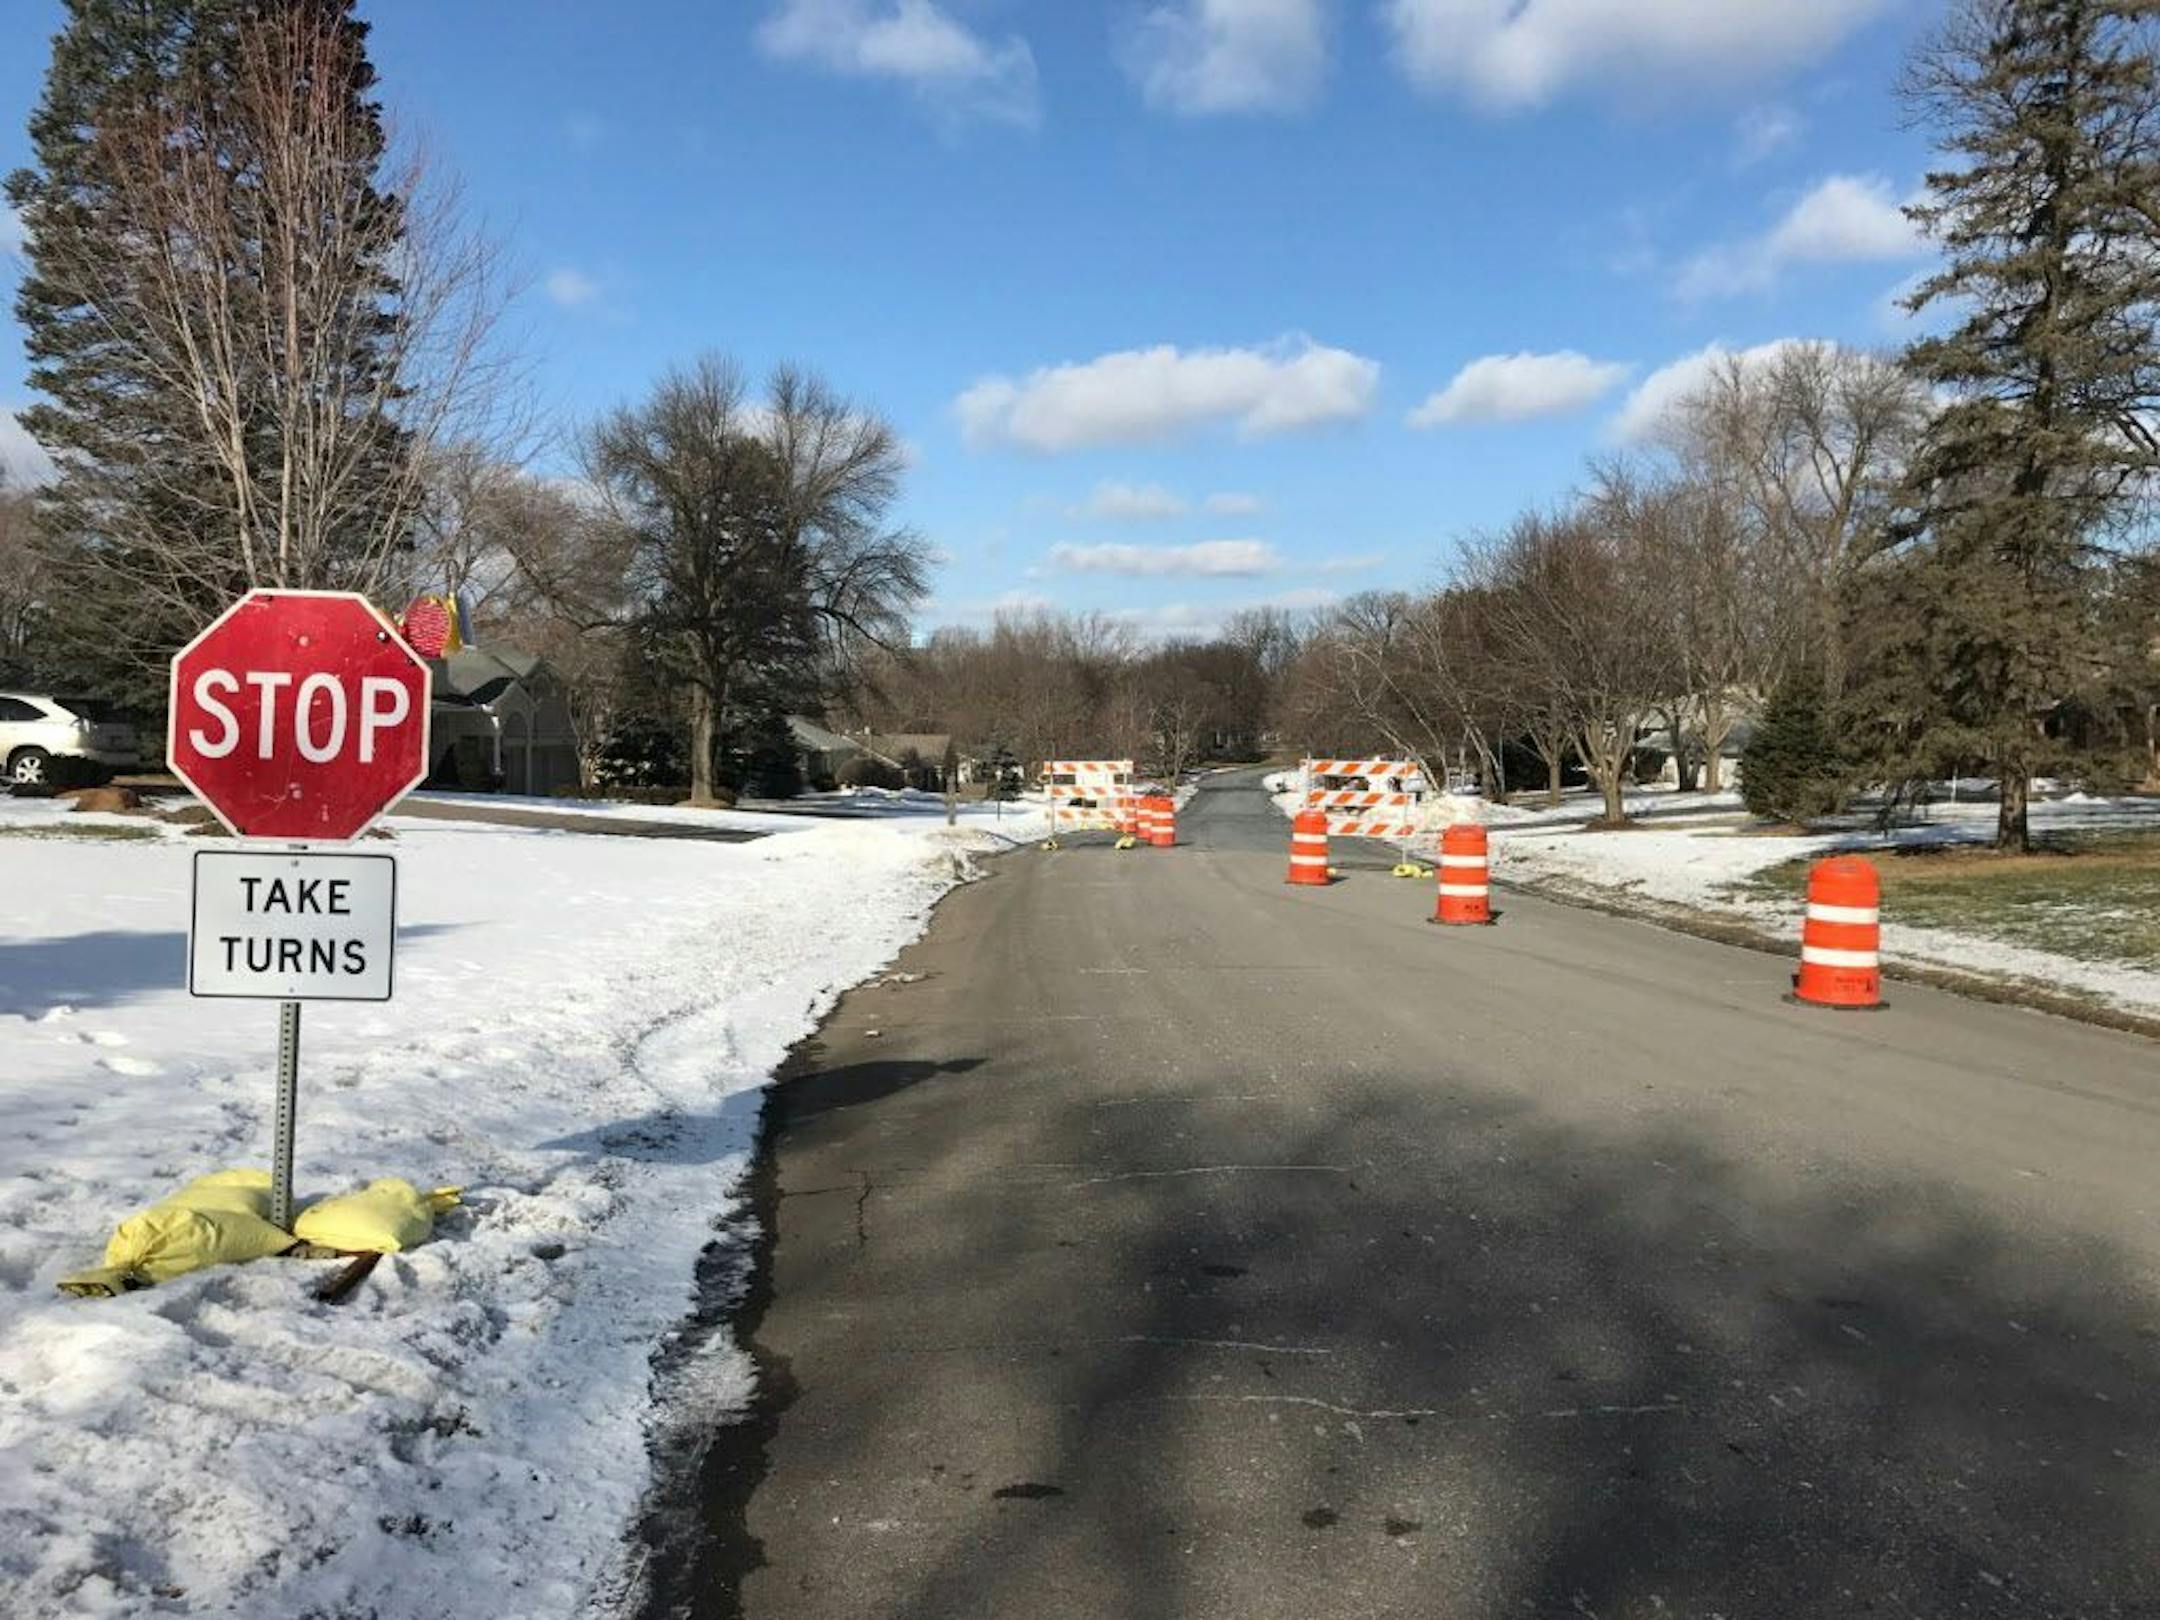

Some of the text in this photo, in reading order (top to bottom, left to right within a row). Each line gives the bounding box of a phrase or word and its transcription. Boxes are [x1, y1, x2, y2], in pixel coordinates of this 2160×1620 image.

[189, 668, 410, 763] STOP
[240, 877, 351, 915] TAKE
[219, 936, 366, 975] TURNS
